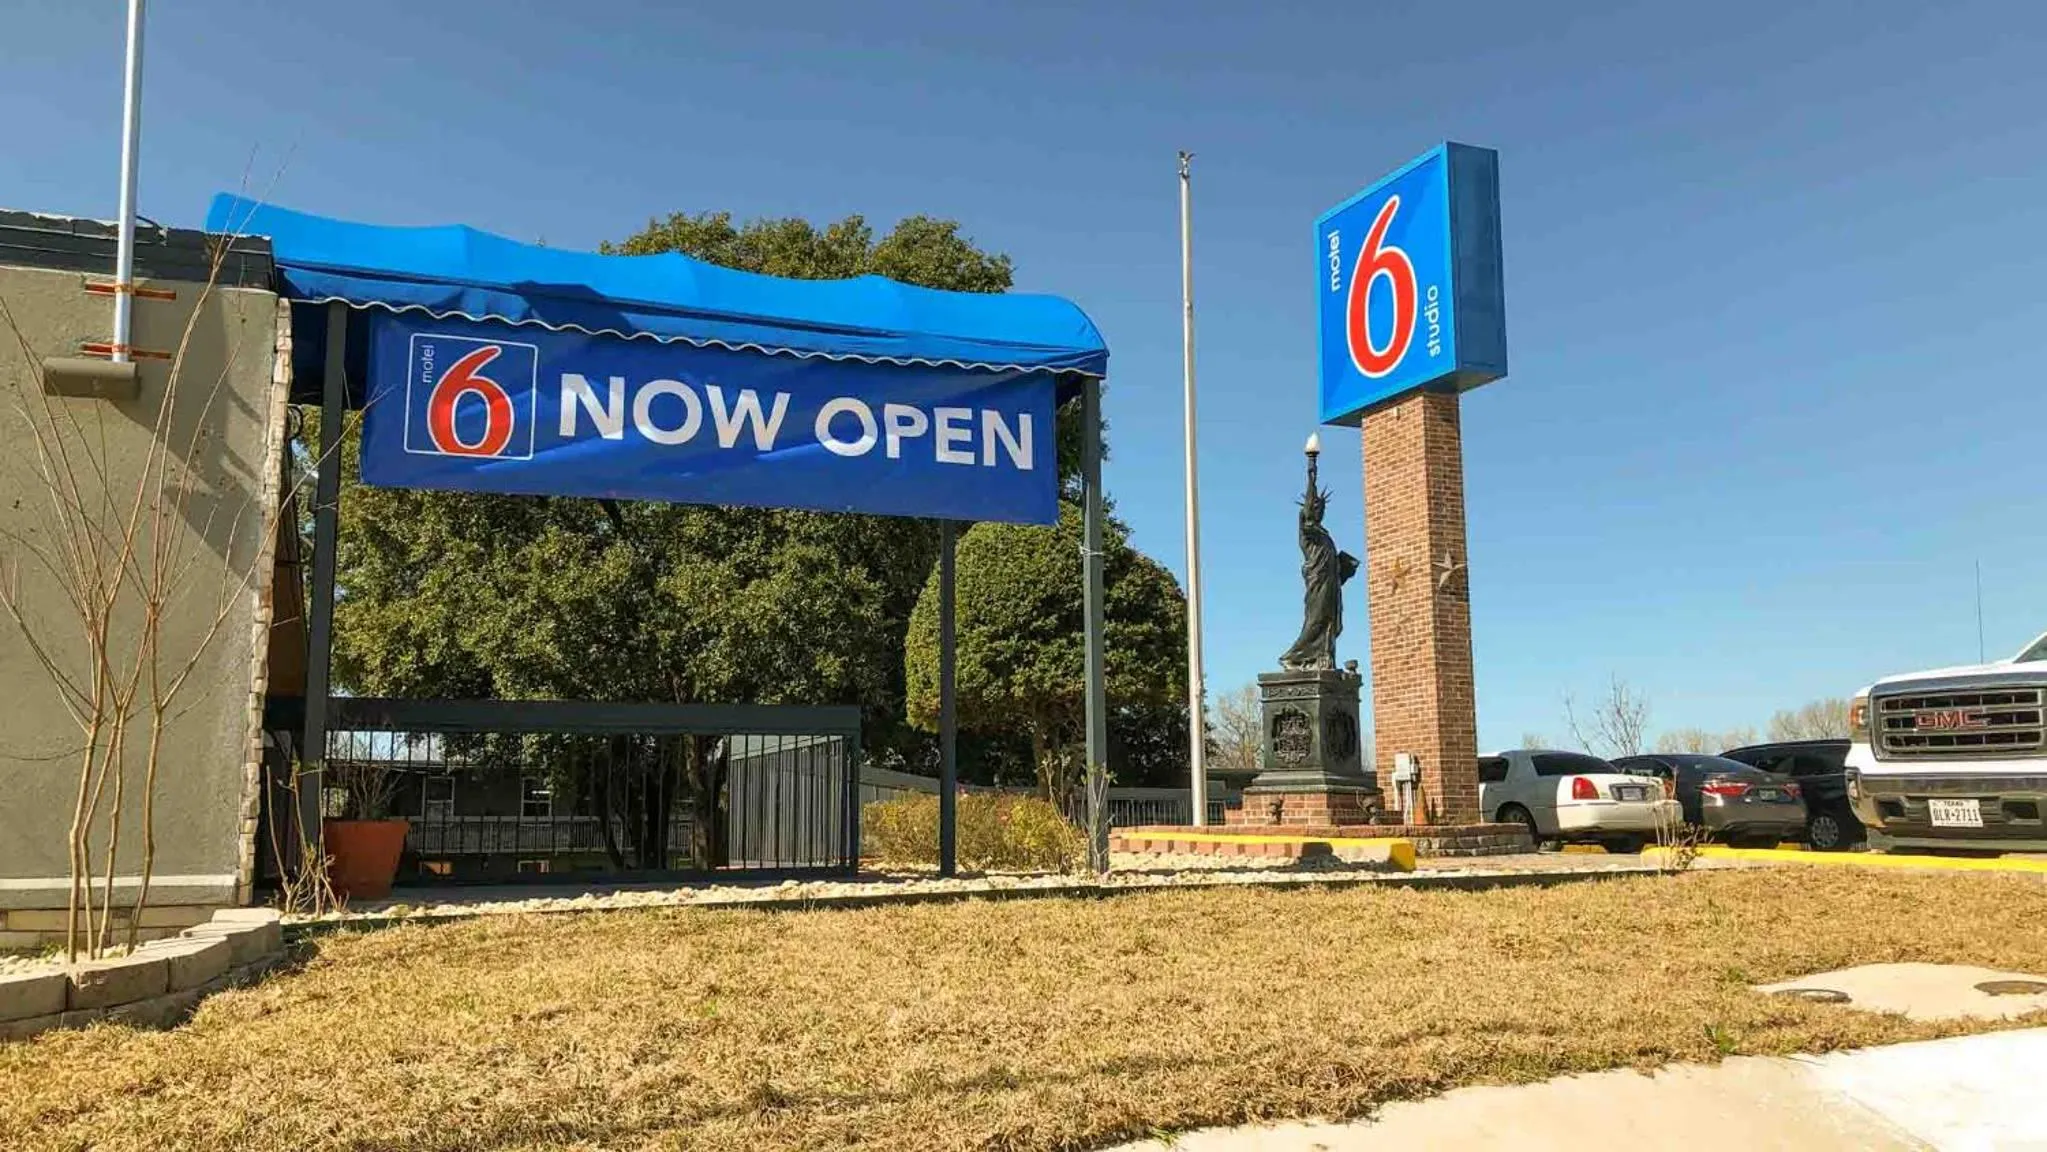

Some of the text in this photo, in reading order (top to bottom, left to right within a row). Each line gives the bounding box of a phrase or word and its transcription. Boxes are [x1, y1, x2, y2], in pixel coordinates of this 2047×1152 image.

[1327, 229, 1341, 292] motel
[1346, 194, 1418, 378] 6
[1424, 284, 1440, 357] studio
[421, 344, 435, 383] motel
[427, 345, 514, 456] 6
[559, 373, 1033, 470] NOW OPEN
[1916, 710, 1986, 729] GMC
